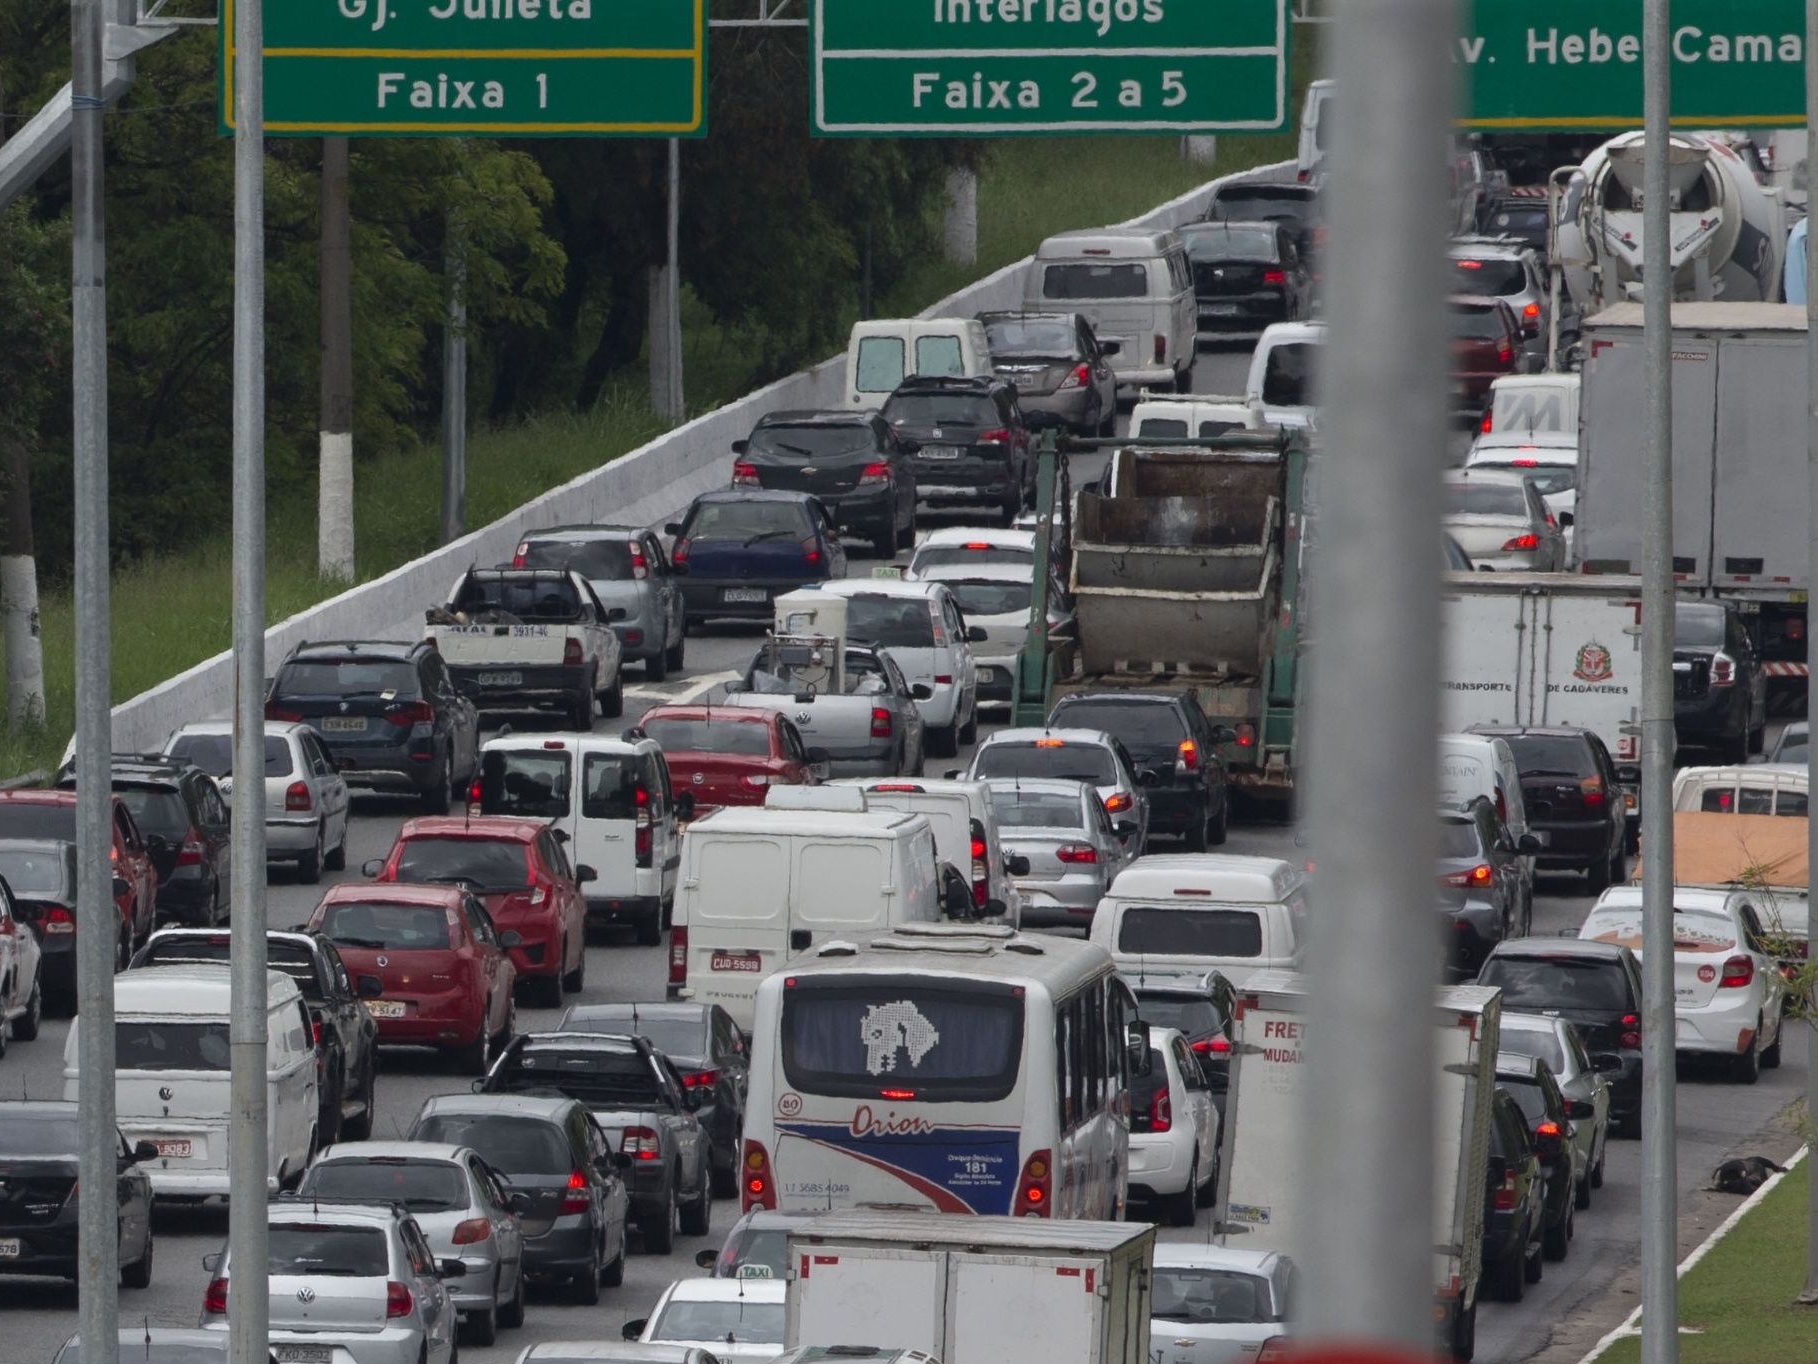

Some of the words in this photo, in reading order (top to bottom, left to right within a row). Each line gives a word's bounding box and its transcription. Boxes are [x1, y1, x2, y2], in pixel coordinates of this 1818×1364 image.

[934, 0, 1164, 37] Interlagos
[1450, 37, 1495, 63] v.
[1526, 28, 1641, 64] Hebe
[377, 72, 504, 109] Faixa
[534, 72, 547, 109] 1
[912, 72, 1040, 109] Faixa
[1070, 71, 1099, 107] 2
[1116, 79, 1143, 107] a
[1162, 70, 1187, 107] 5
[1548, 684, 1560, 693] DE
[852, 1104, 935, 1136] Orion
[965, 1162, 988, 1173] 181
[743, 1266, 769, 1278] TAXI
